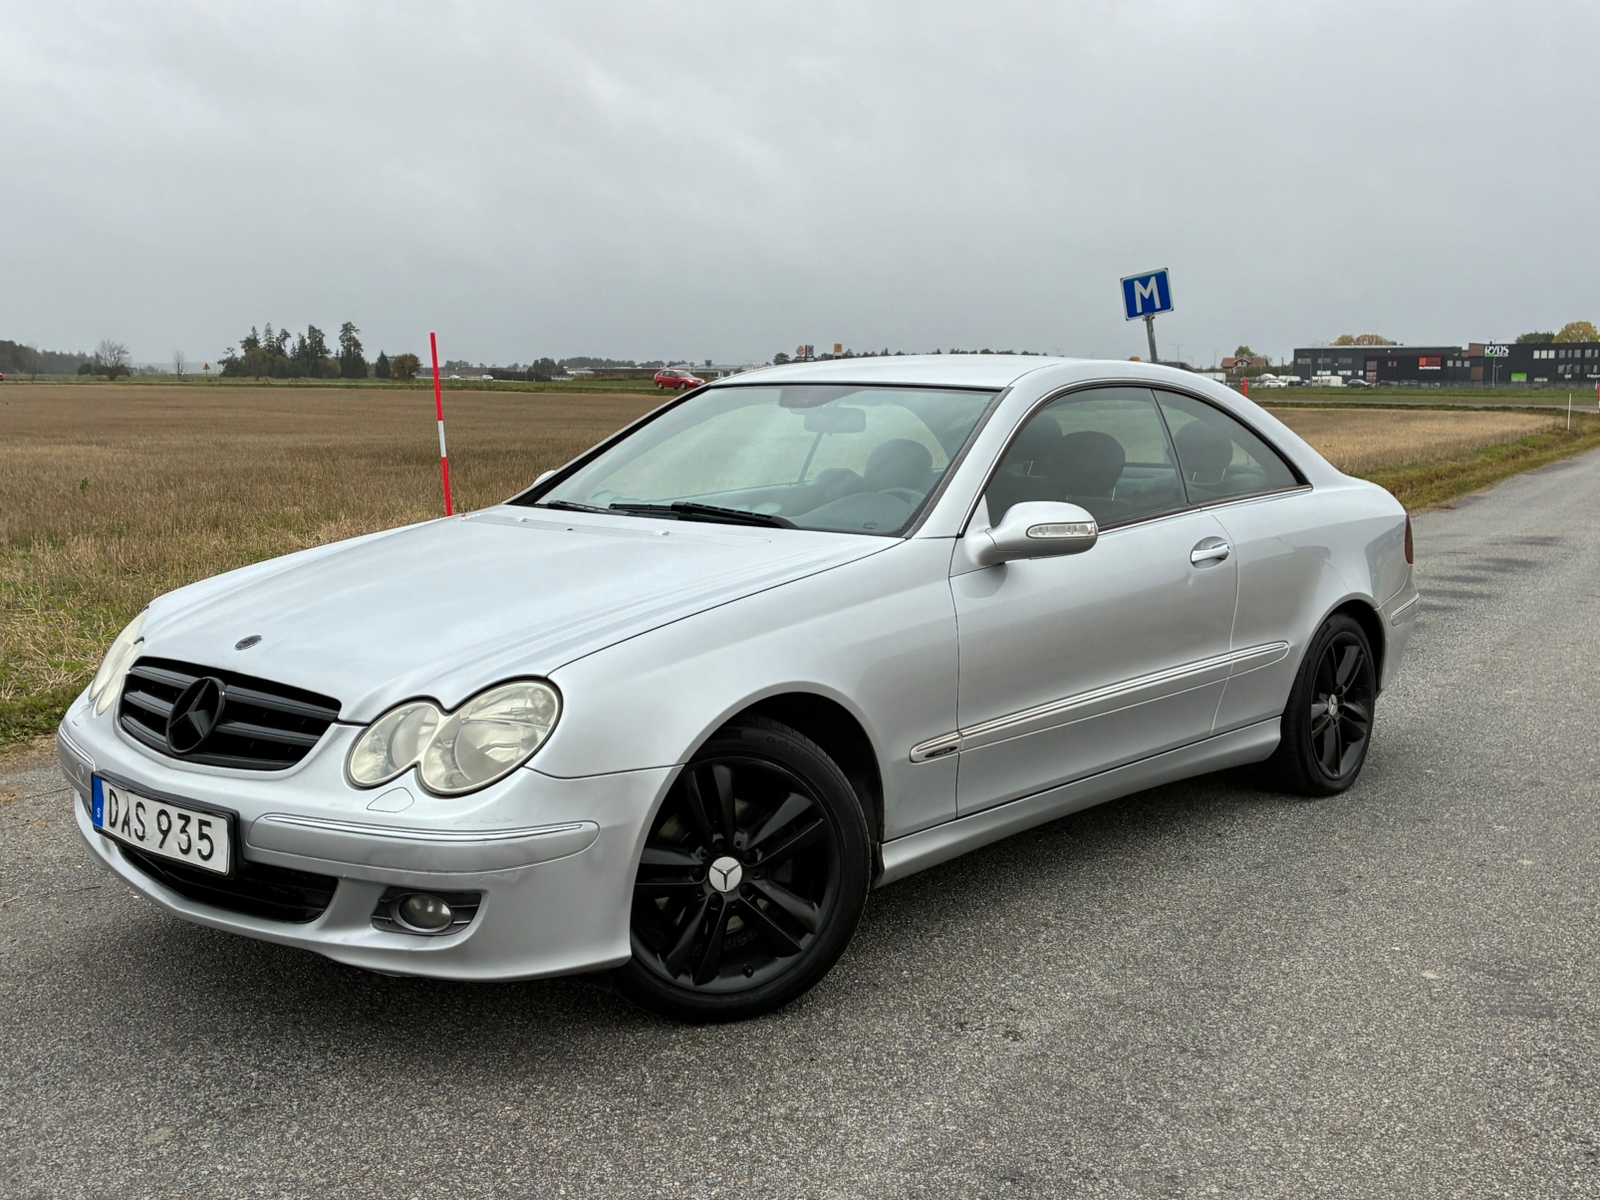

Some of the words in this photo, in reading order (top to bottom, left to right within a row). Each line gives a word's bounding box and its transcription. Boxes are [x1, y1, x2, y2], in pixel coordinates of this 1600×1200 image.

[1134, 276, 1161, 313] M
[97, 807, 102, 818] S
[108, 788, 146, 842] DAS
[156, 808, 214, 861] 935
